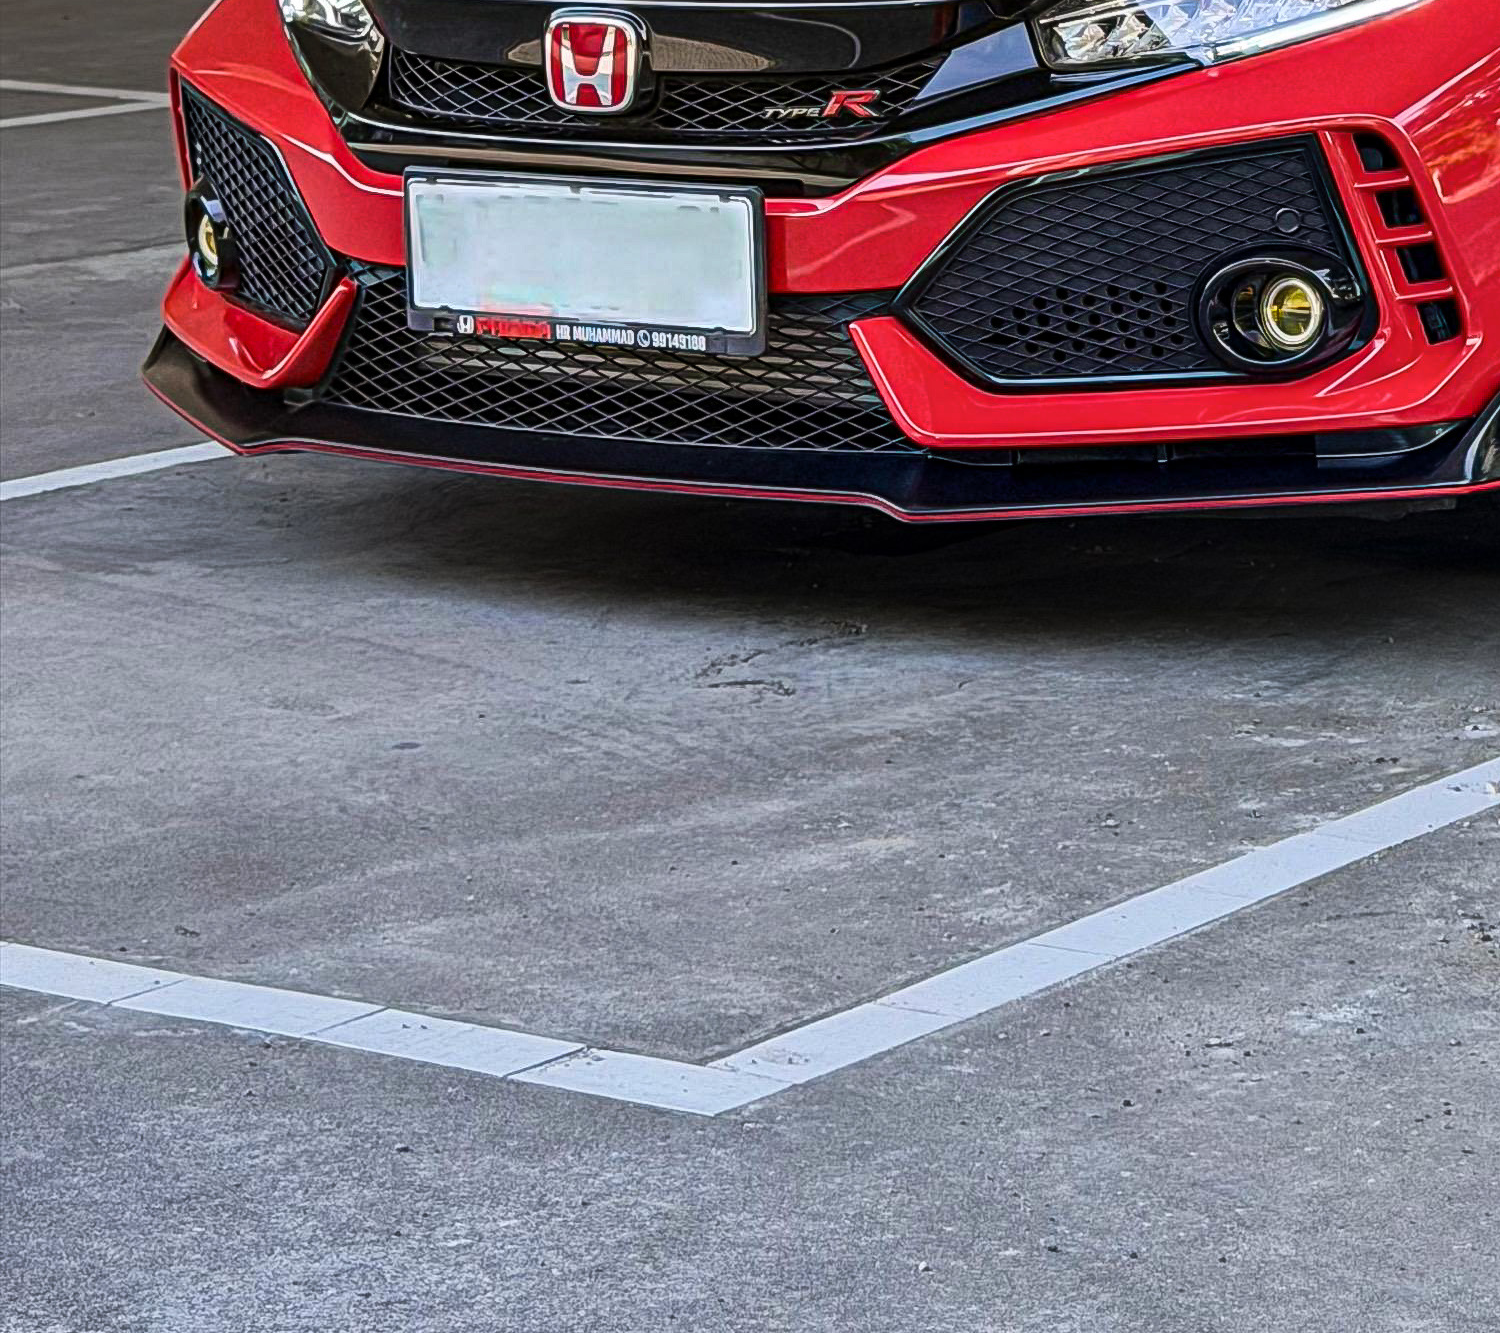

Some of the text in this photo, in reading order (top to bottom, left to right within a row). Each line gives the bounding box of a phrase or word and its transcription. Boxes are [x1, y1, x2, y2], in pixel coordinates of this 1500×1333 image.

[762, 88, 886, 119] TYPE R
[572, 325, 635, 345] MUHAMMAD
